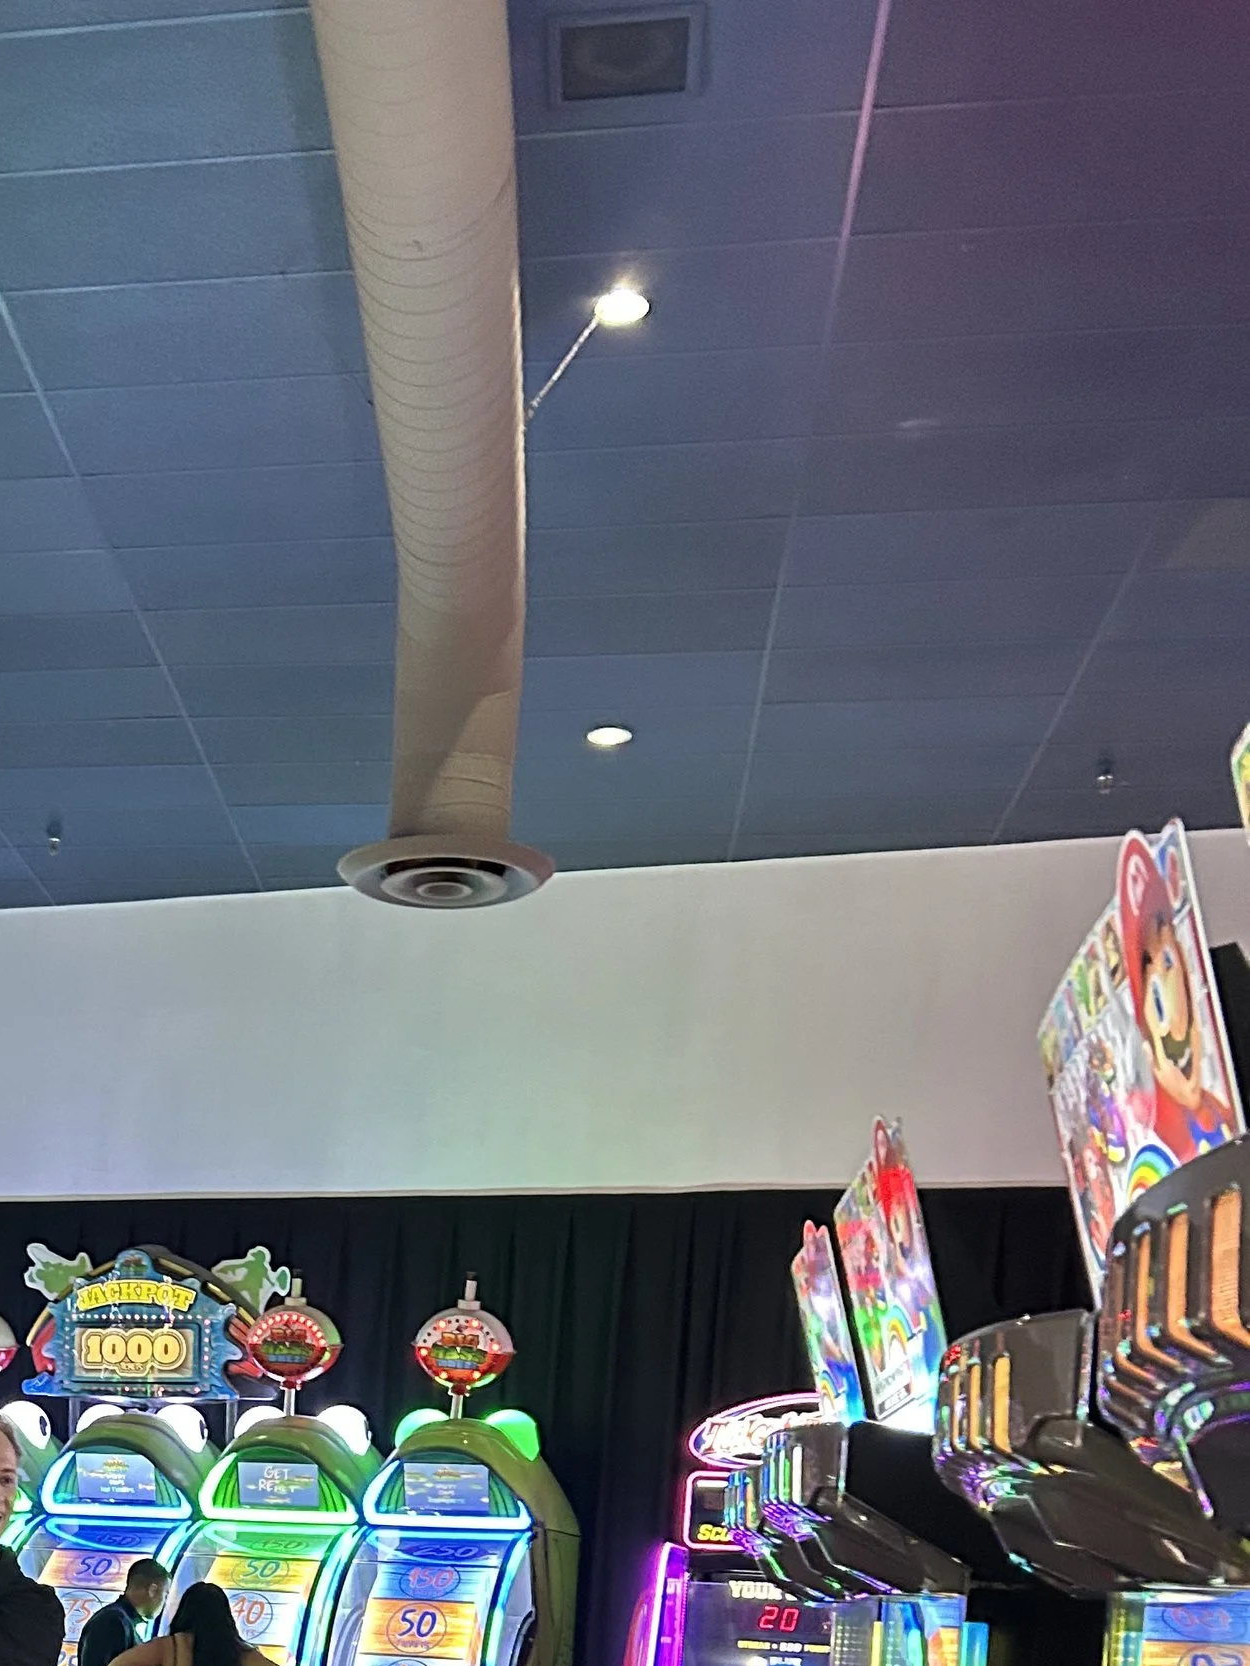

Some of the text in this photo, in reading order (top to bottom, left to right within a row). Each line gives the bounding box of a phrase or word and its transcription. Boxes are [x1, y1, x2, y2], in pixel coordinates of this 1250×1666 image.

[79, 1280, 194, 1309] JACKPOT
[83, 1334, 181, 1364] 1000
[74, 1556, 113, 1577] 50
[242, 1558, 281, 1578] 50
[409, 1566, 455, 1589] 150
[397, 1608, 437, 1638] 50
[759, 1605, 800, 1633] 20
